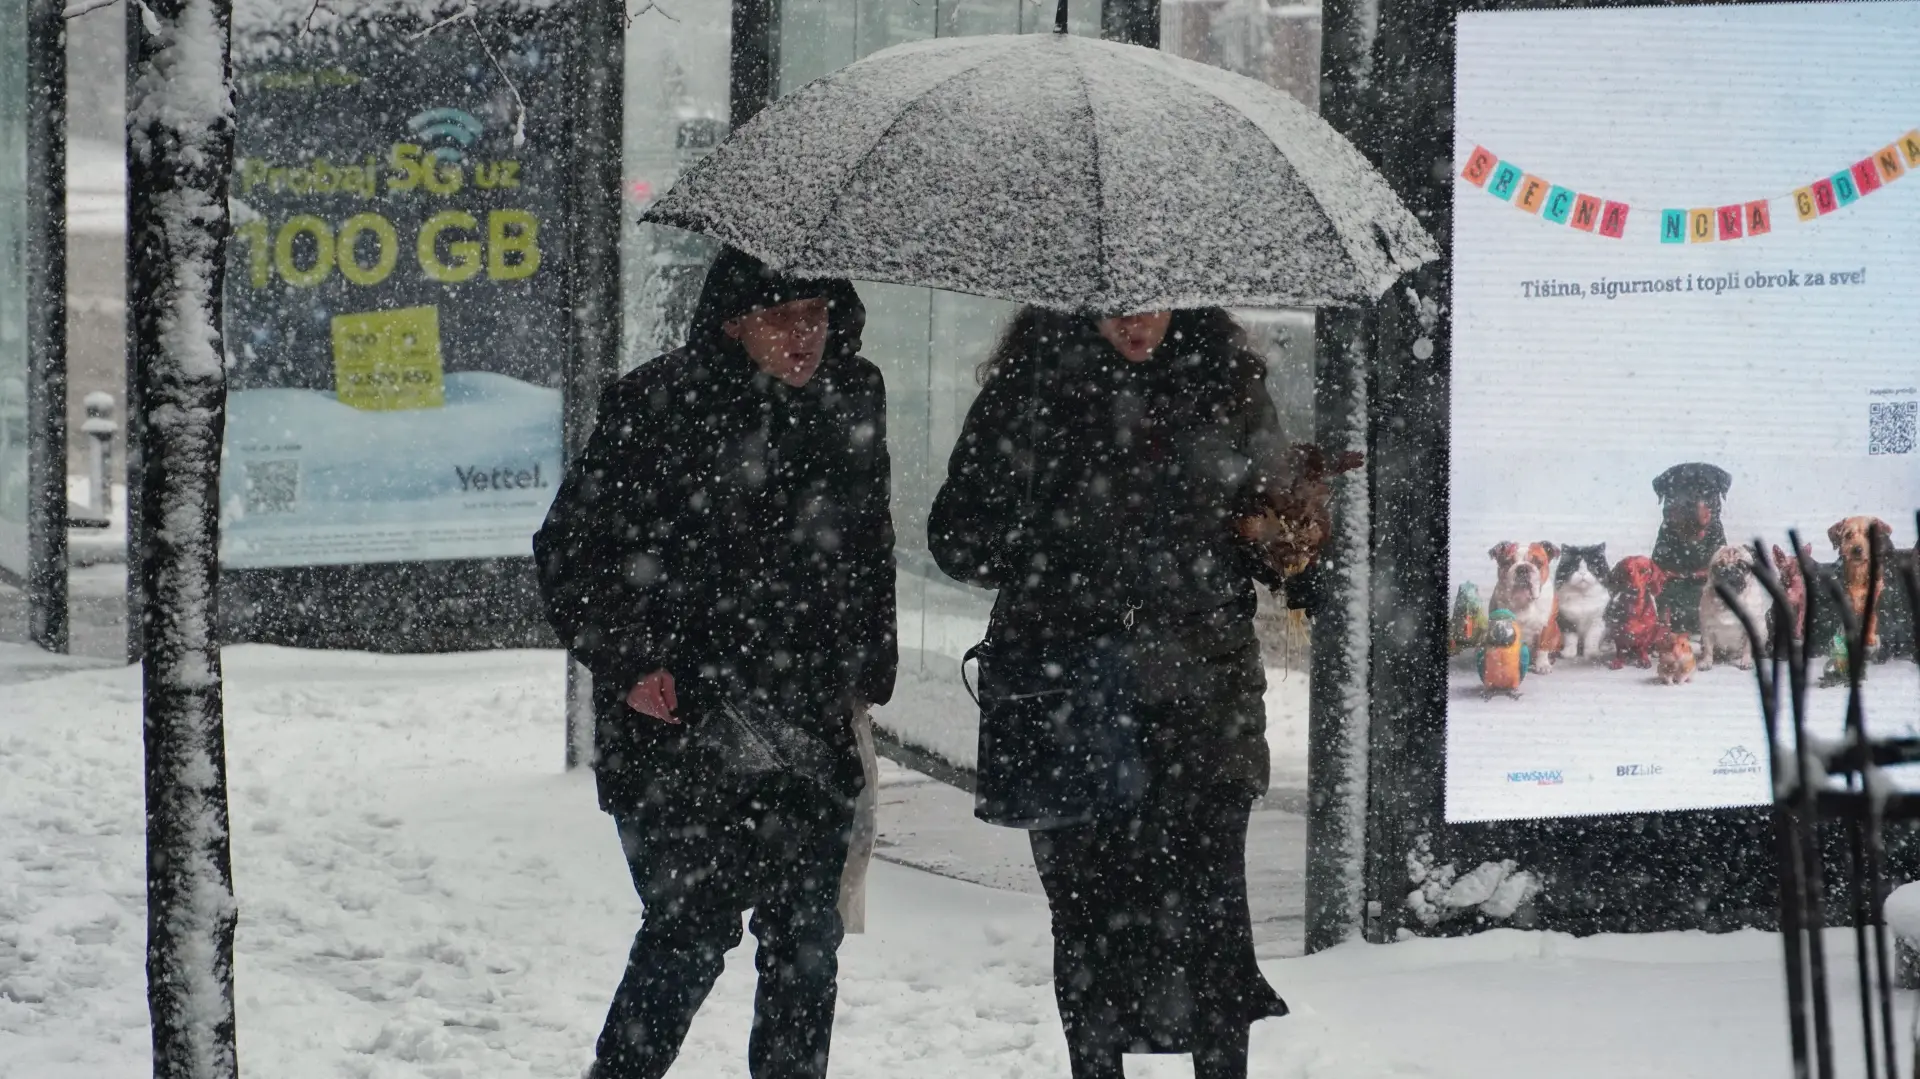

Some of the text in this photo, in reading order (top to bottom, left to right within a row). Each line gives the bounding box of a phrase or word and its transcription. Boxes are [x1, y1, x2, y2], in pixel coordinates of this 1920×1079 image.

[241, 141, 521, 200] Probaj 5G uz
[1666, 211, 1767, 239] NOVA
[1799, 138, 1920, 217] GODINA
[236, 209, 541, 289] 100 GB
[1521, 267, 1866, 299] Tišina, sigurnost i topli obrok za sve!
